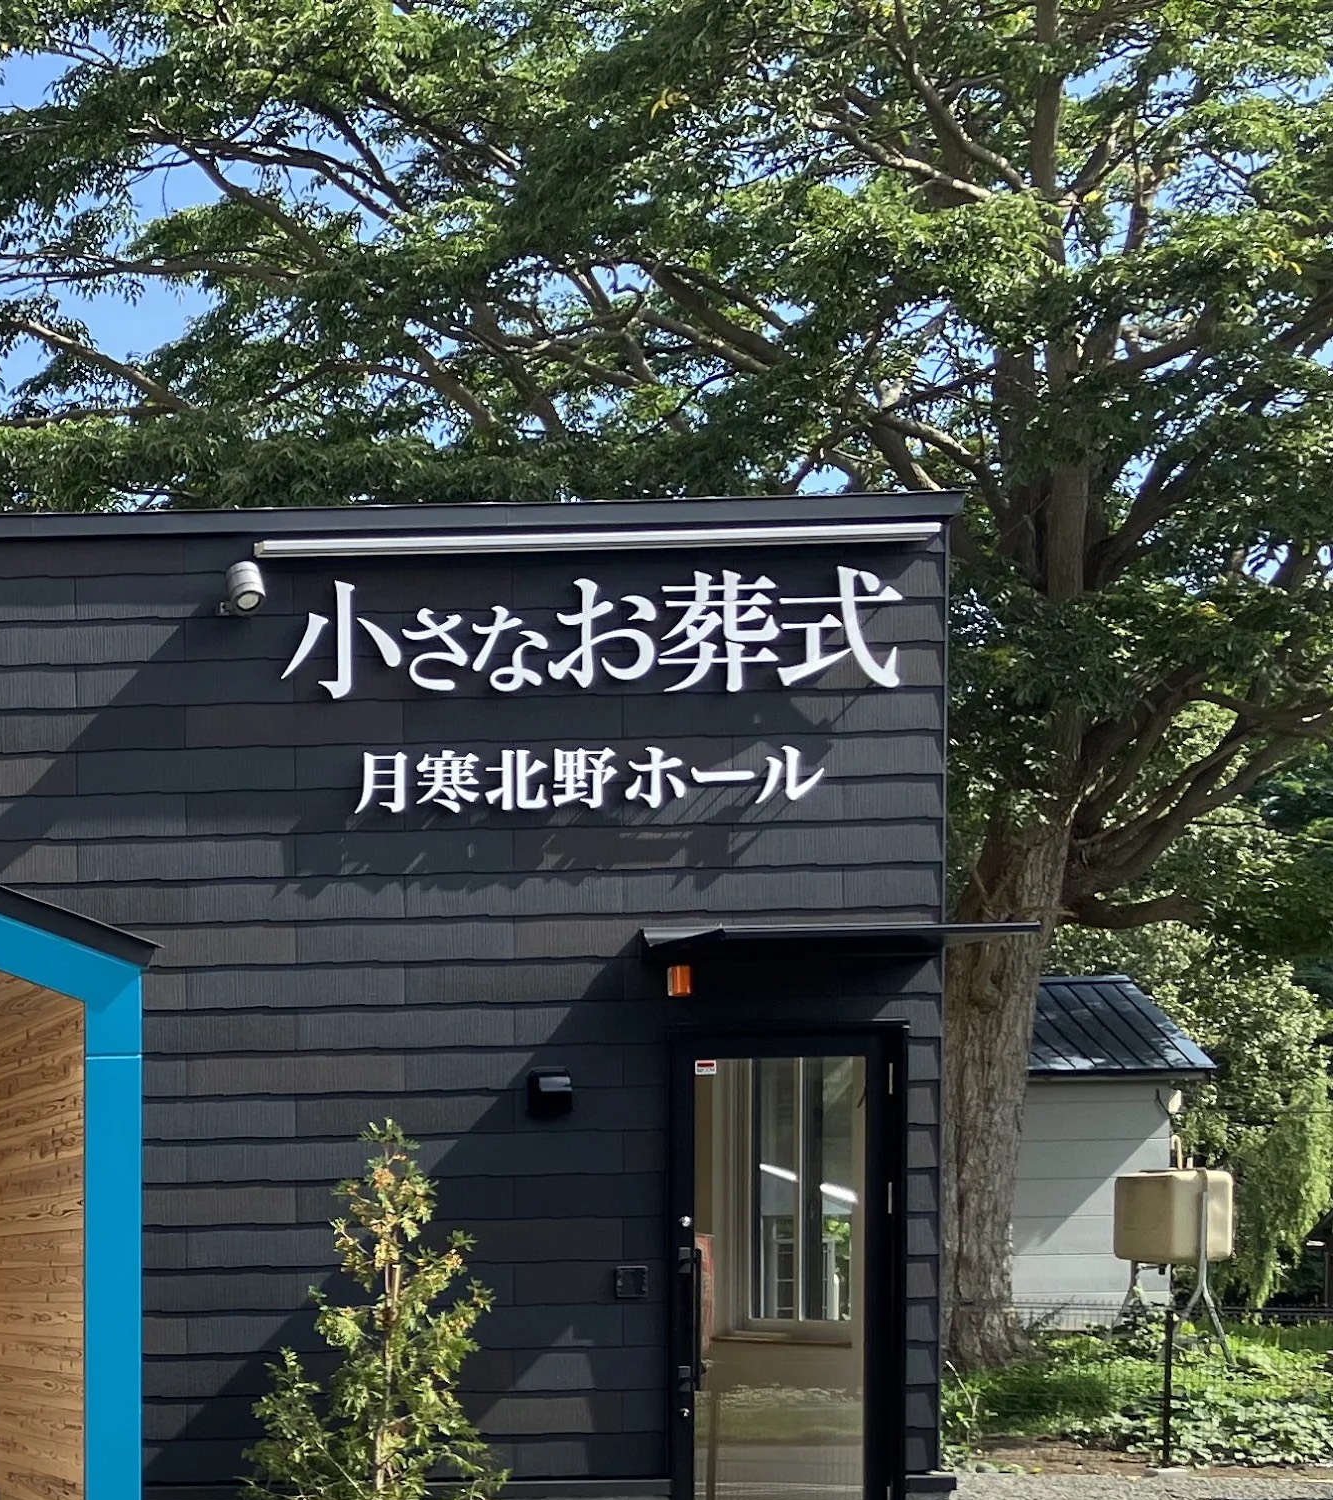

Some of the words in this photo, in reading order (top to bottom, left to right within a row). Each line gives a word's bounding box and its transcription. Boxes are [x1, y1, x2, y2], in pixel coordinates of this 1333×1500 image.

[281, 565, 903, 699] 小さなお葬式
[354, 745, 825, 814] 月寒北野ホール
